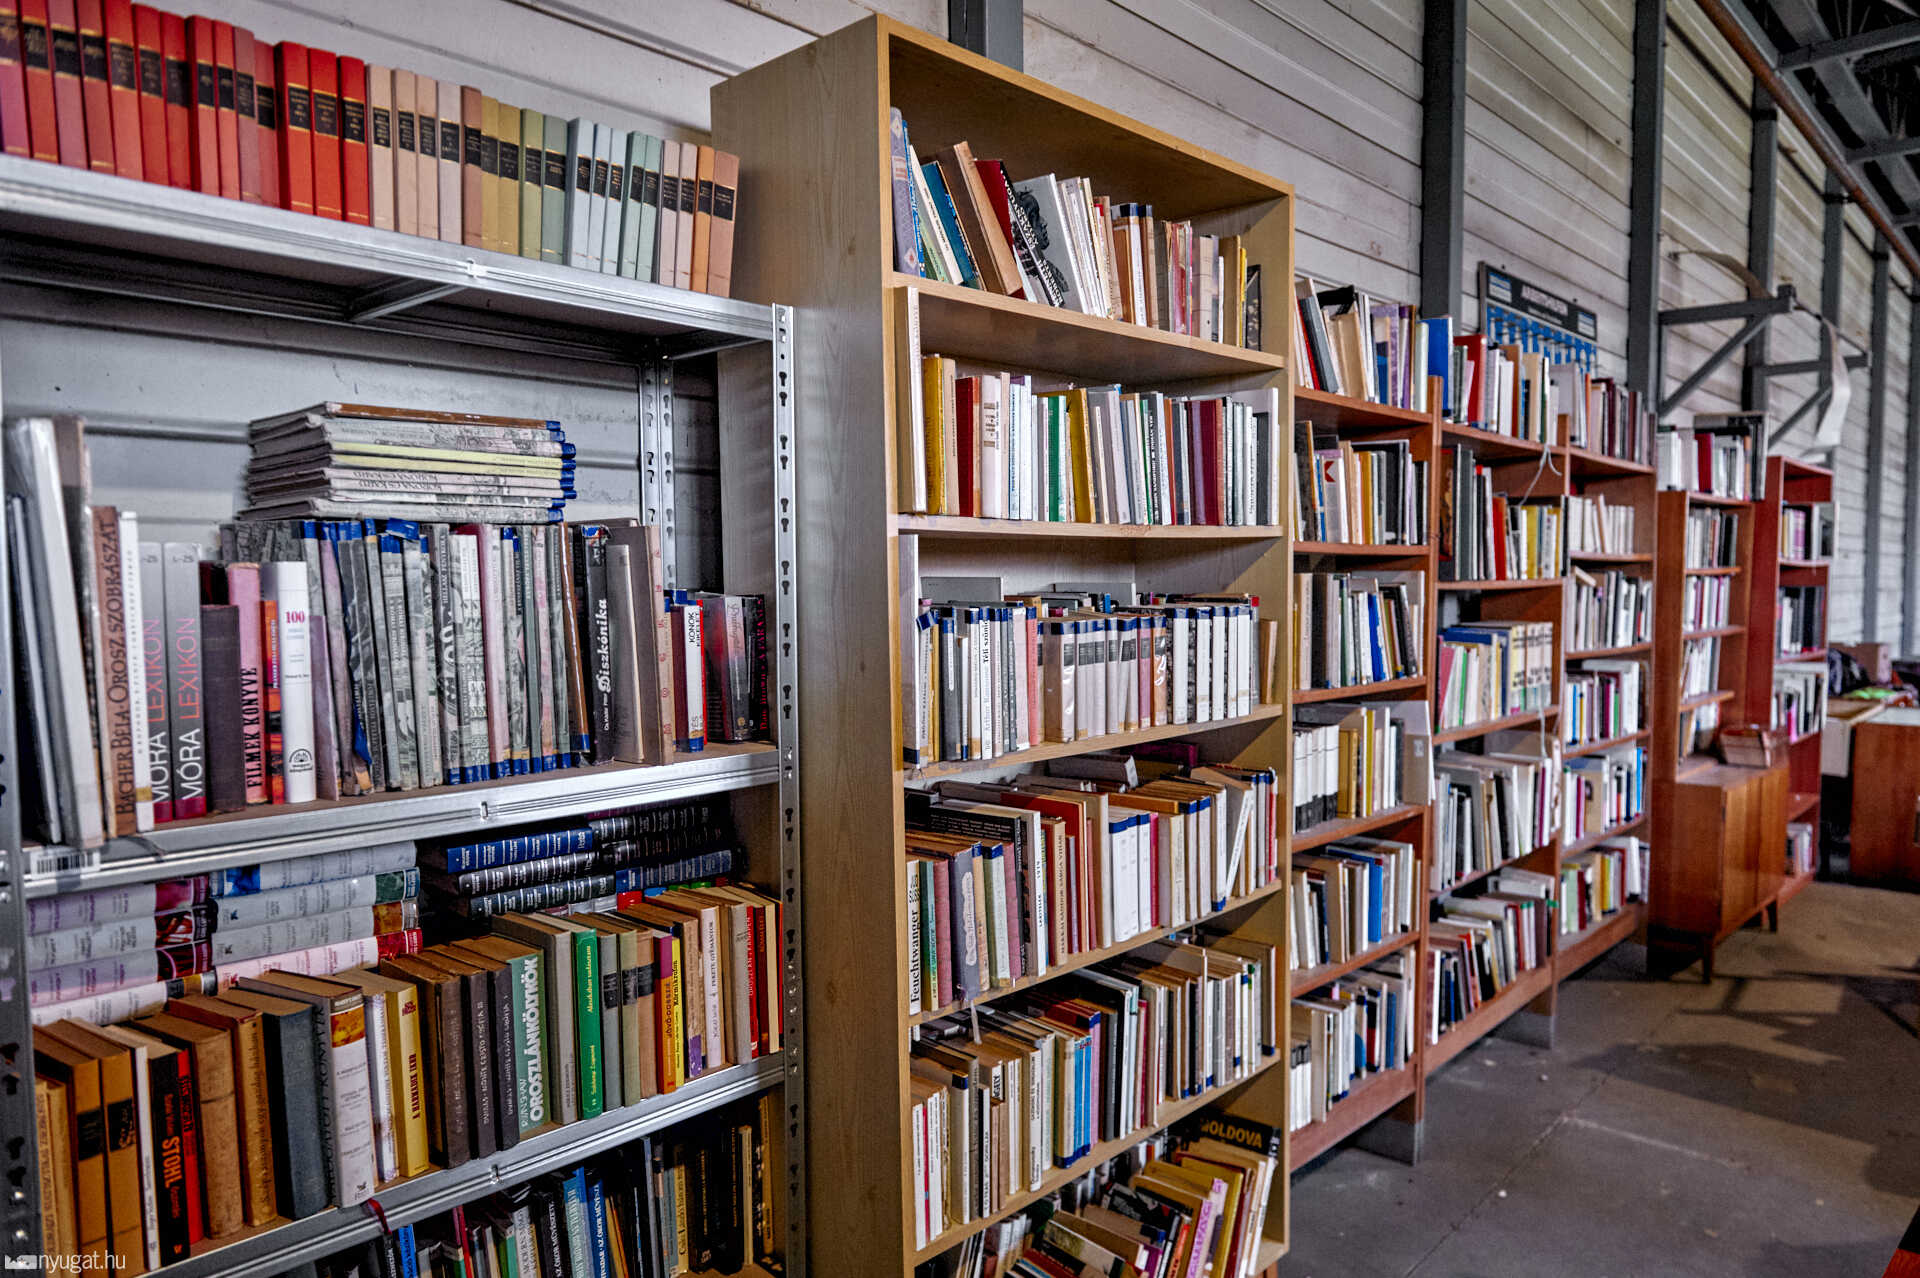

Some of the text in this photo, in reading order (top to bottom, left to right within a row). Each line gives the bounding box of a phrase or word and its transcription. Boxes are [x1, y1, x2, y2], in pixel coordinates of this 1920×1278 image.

[98, 518, 123, 633] SZOBRÁSZAT
[285, 610, 306, 625] 100
[595, 599, 612, 693] Diszkónika
[688, 612, 696, 643] KONOK
[106, 638, 127, 704] OROSZ
[143, 618, 166, 723] LEXIKON
[982, 649, 990, 663] Téli
[110, 710, 131, 749] BÉLA
[176, 617, 202, 800] MÓRA LEXIKON
[113, 751, 135, 815] BACHER
[244, 731, 262, 787] FILMEK
[910, 910, 920, 1003] Feuchtwanger
[409, 1053, 417, 1071] IKER
[521, 957, 544, 1121] OROSZLÁNKÖLYKÖK
[411, 1073, 420, 1111] HARMADIK
[162, 1135, 183, 1188] STOHL
